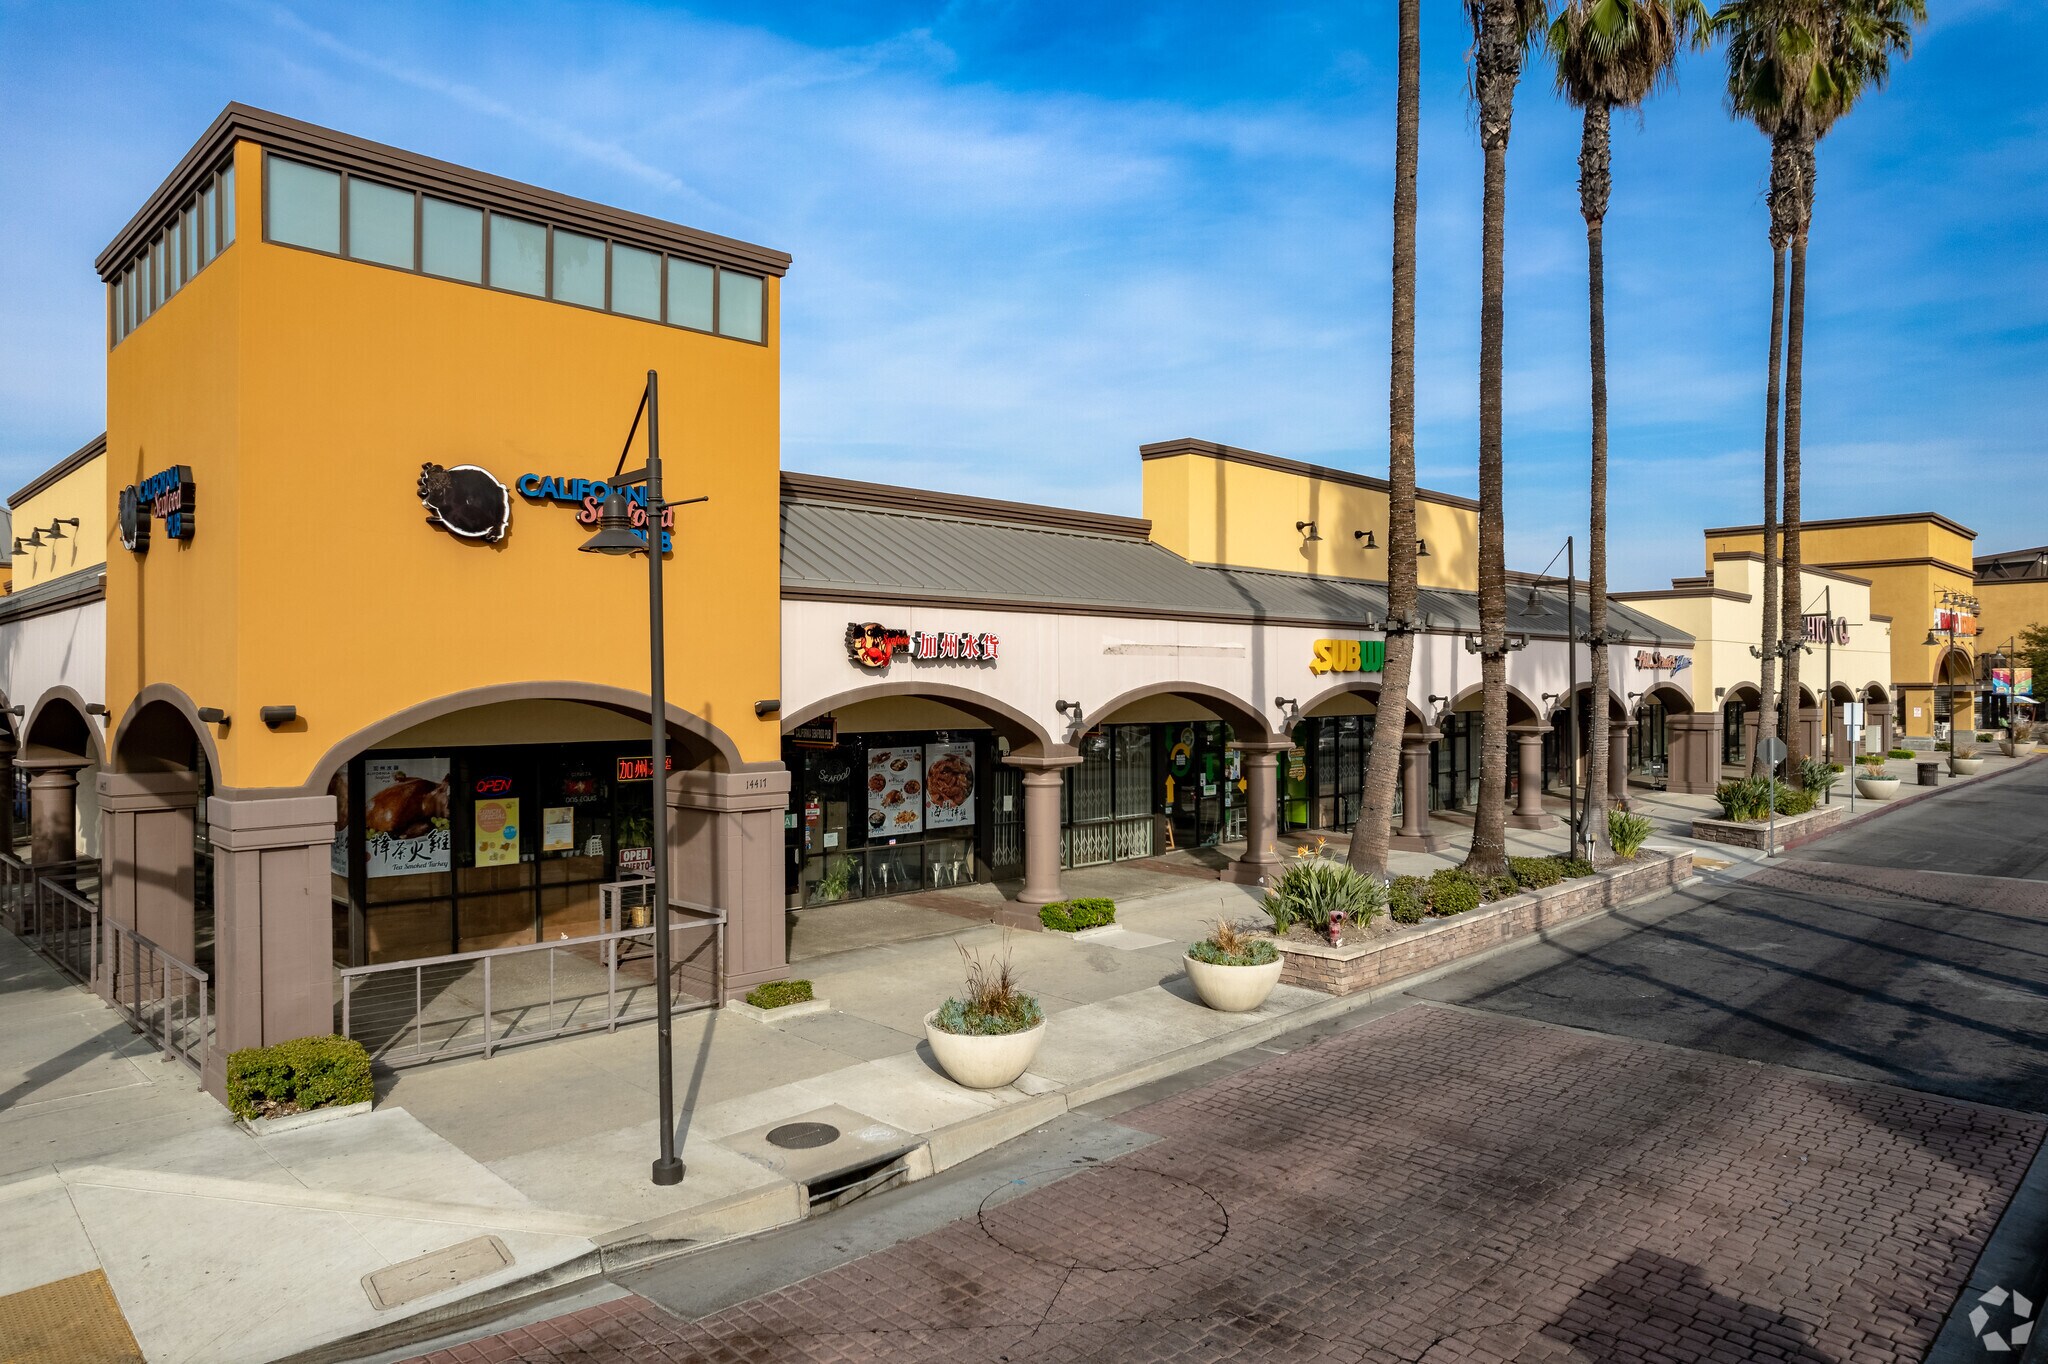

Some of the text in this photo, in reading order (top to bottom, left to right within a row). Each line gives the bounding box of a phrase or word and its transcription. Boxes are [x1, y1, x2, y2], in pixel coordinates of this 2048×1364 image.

[139, 465, 180, 503] CALIFORNIA
[154, 483, 181, 521] Seafood
[168, 512, 180, 538] PUB
[1801, 616, 1850, 645] HION Q
[1309, 639, 1385, 676] SUBW
[476, 780, 512, 793] OPEN
[746, 778, 767, 790] 14417
[784, 817, 791, 826] A
[404, 861, 427, 869] Smoked
[428, 860, 449, 869] Turkey
[623, 849, 648, 861] OPEN
